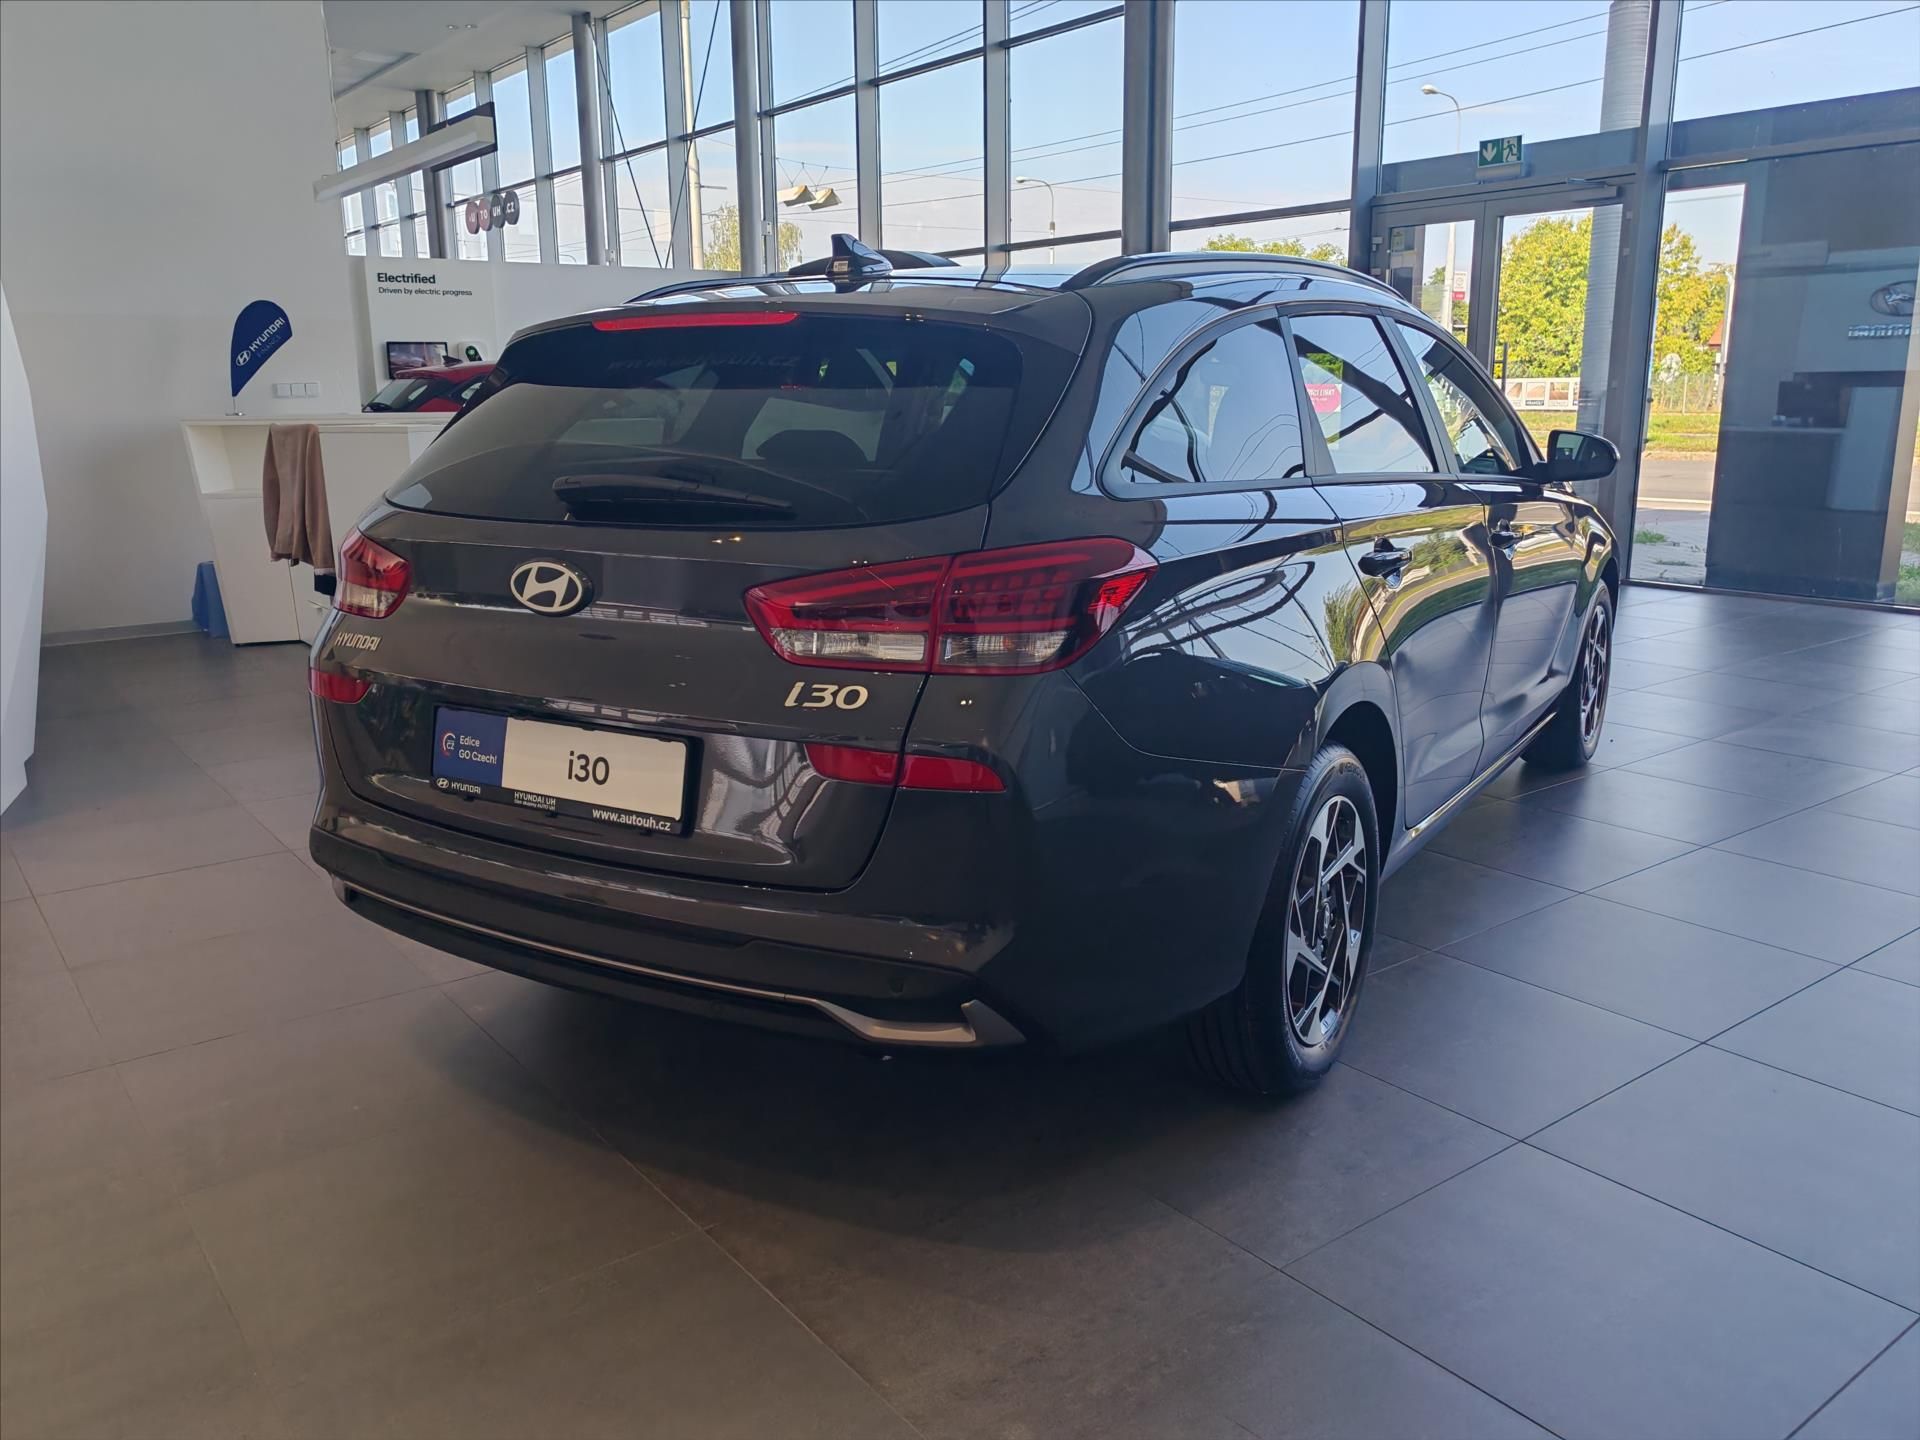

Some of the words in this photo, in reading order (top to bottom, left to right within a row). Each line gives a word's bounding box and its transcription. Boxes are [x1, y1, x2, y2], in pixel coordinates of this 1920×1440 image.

[492, 205, 501, 217] UH
[377, 272, 436, 284] Electrified
[378, 286, 402, 295] Driven
[404, 287, 413, 296] by
[414, 288, 441, 296] electric
[442, 289, 473, 297] progress
[249, 317, 286, 352] HYUNDAI
[334, 631, 382, 651] HYUNDAI
[784, 681, 869, 710] i30
[459, 735, 481, 747] Edice
[458, 749, 471, 760] GO
[472, 751, 497, 764] Czech!
[568, 750, 610, 785] i30
[451, 781, 481, 795] HYUNDAI
[514, 791, 545, 804] HYUNDAI
[545, 797, 556, 806] UH
[592, 808, 672, 832] www.autouh.cz
